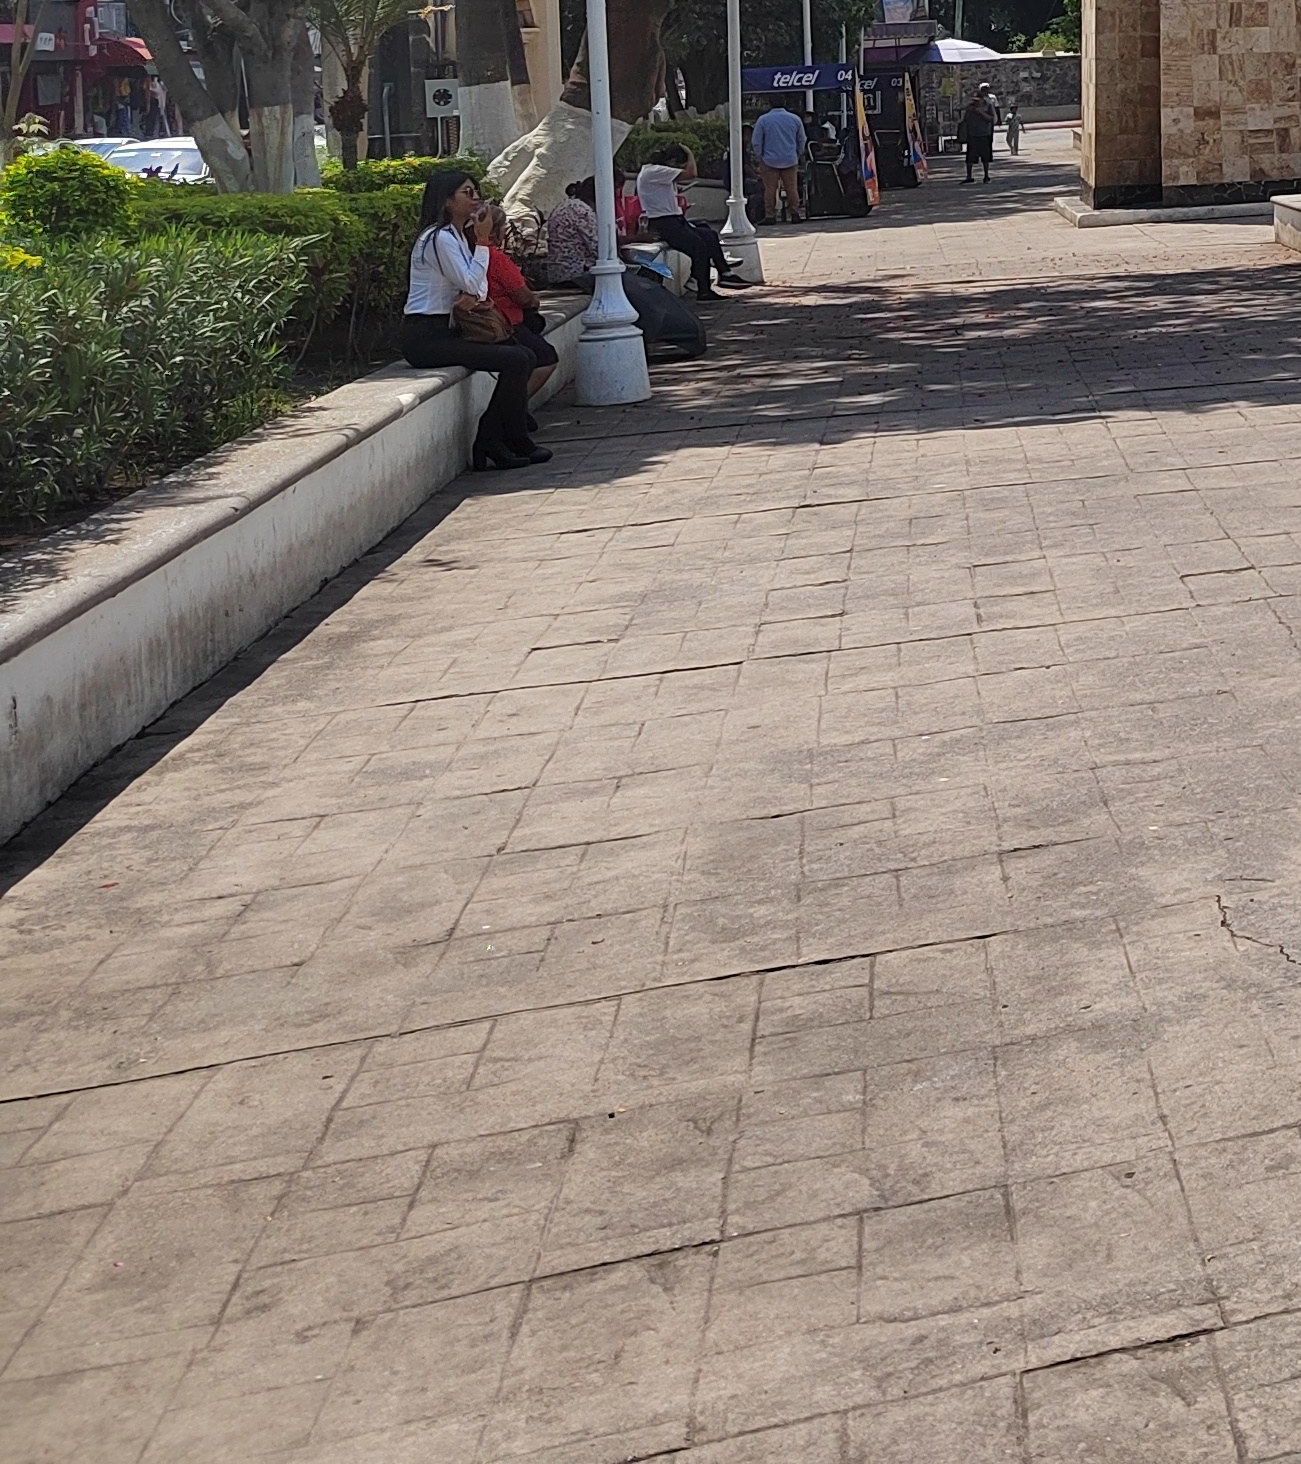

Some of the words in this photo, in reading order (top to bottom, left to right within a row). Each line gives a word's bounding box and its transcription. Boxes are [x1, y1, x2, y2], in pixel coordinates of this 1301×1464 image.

[773, 69, 820, 88] telcel
[837, 69, 853, 81] 04
[890, 77, 903, 87] 03
